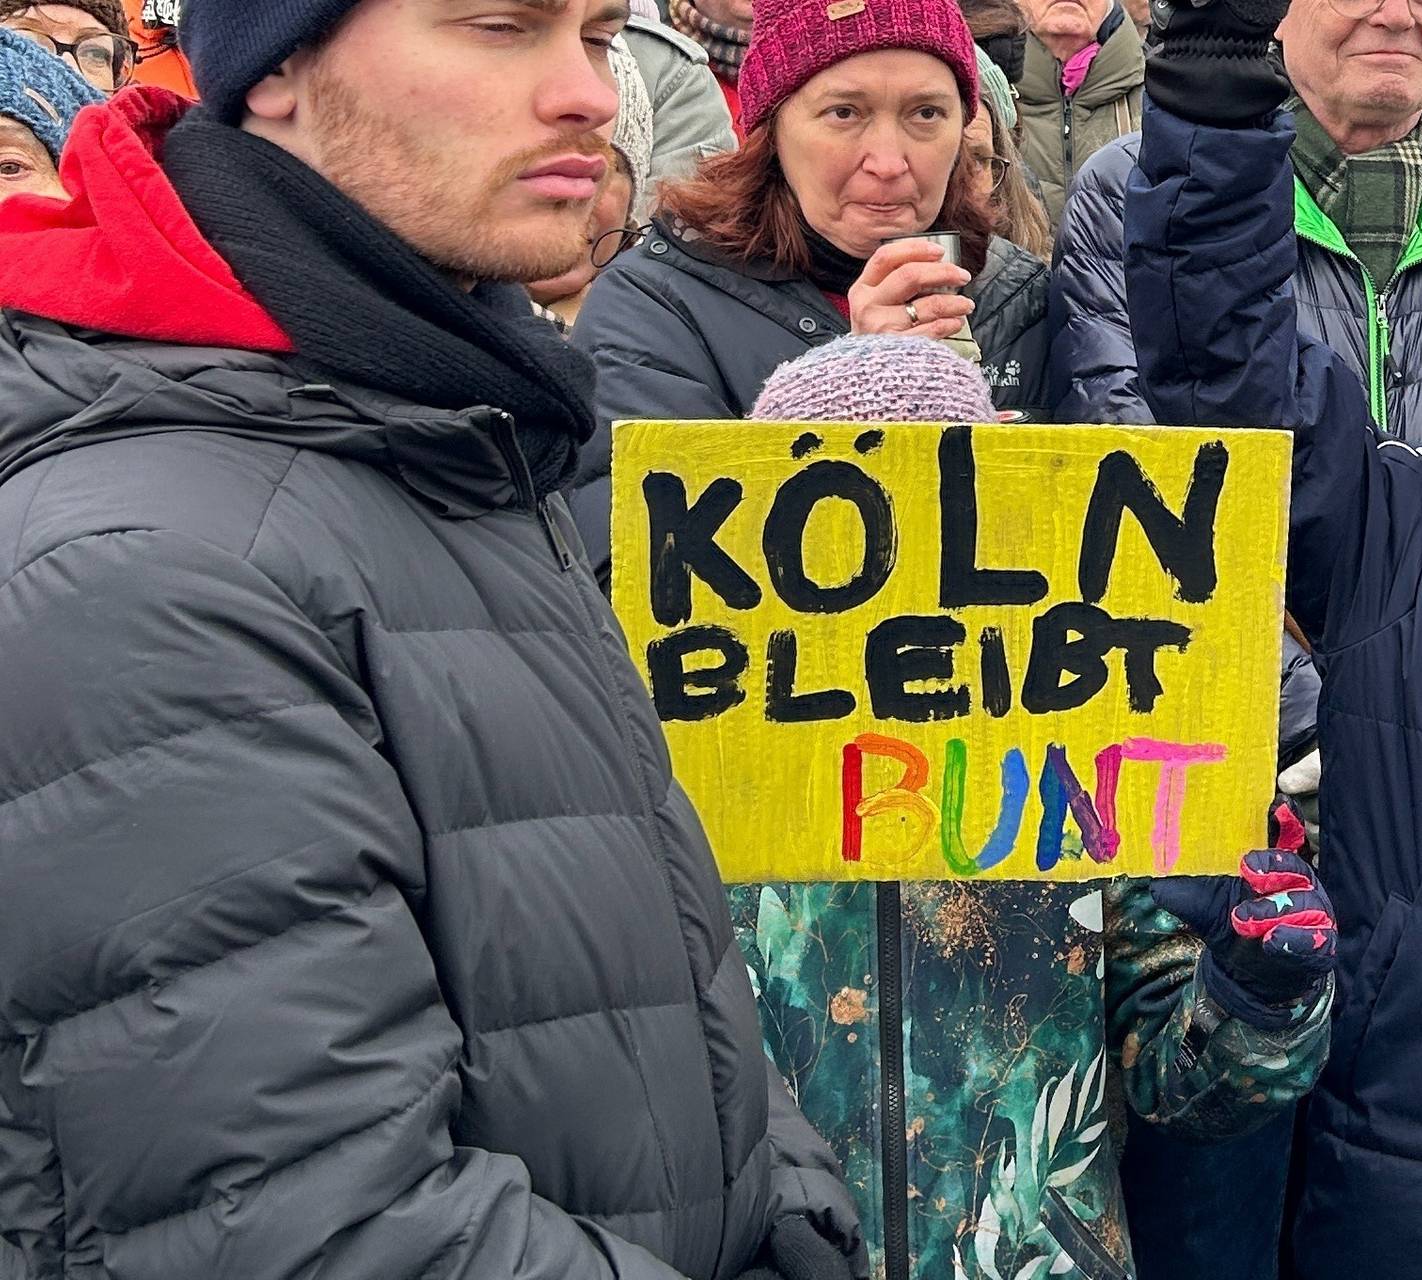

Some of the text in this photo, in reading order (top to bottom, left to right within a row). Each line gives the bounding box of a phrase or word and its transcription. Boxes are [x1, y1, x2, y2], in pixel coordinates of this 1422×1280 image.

[642, 427, 1229, 626] KÖLN
[648, 602, 1193, 722] BLEIBT
[842, 733, 1227, 875] BUNT
